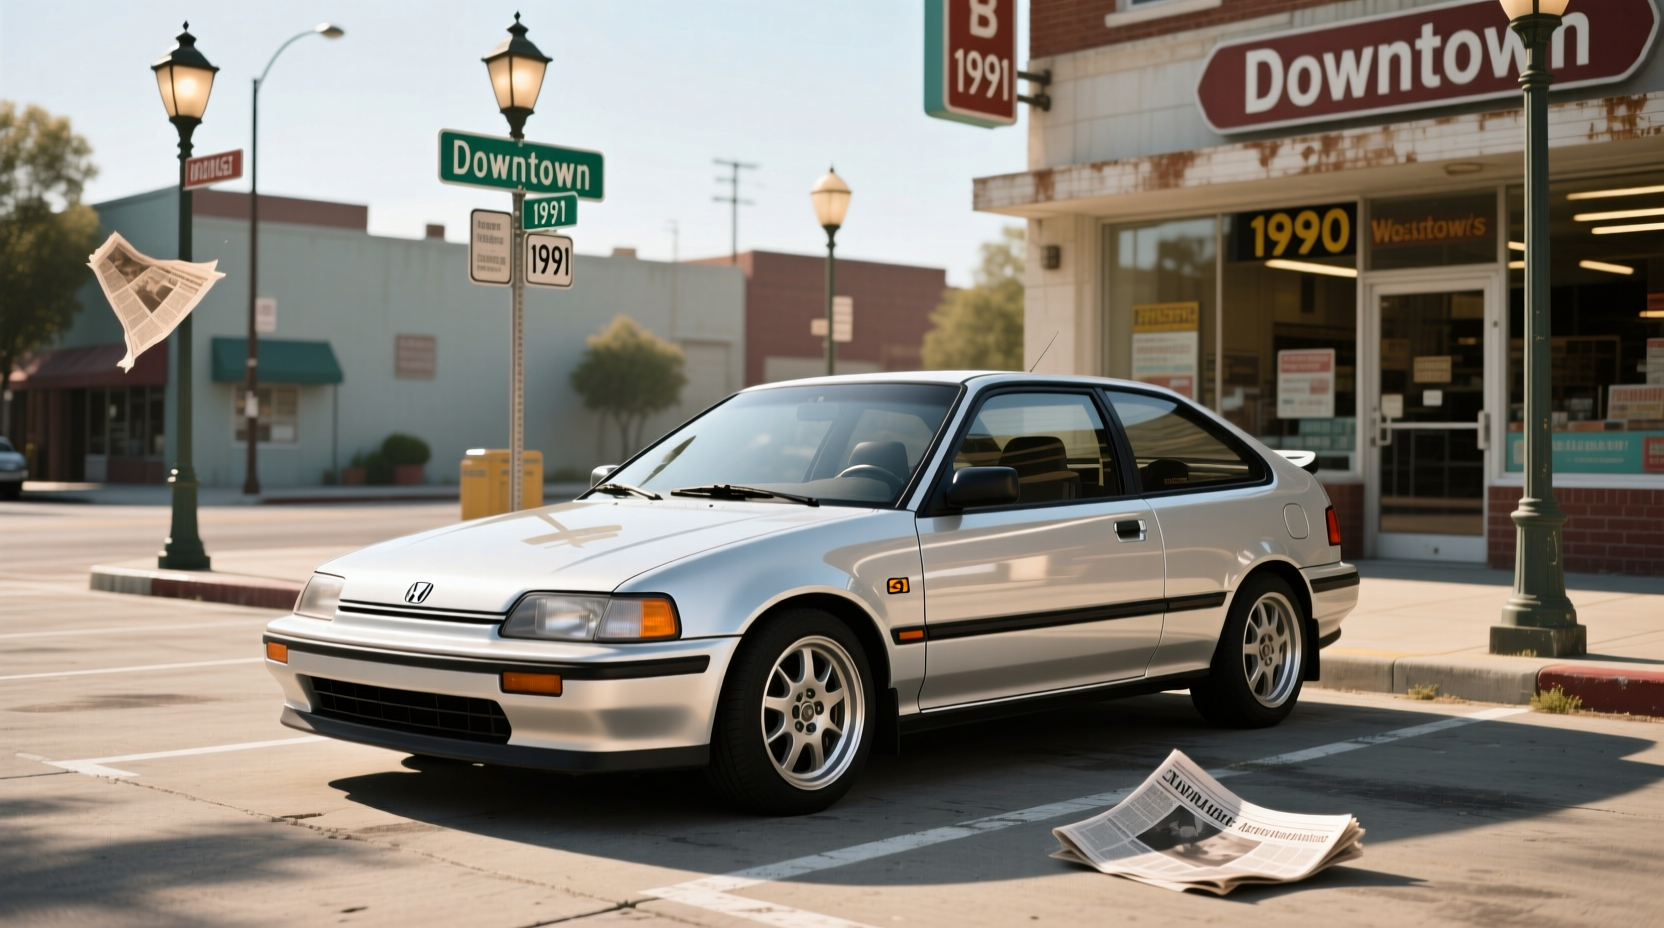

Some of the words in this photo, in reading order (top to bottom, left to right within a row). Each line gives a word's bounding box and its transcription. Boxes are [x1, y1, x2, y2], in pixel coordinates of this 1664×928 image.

[969, 0, 998, 39] B
[954, 48, 1009, 102] 1991
[1245, 11, 1590, 114] Downtown
[453, 139, 590, 191] Downtown
[533, 200, 566, 225] 1991
[1249, 207, 1350, 258] 1990
[531, 244, 570, 276] 1991
